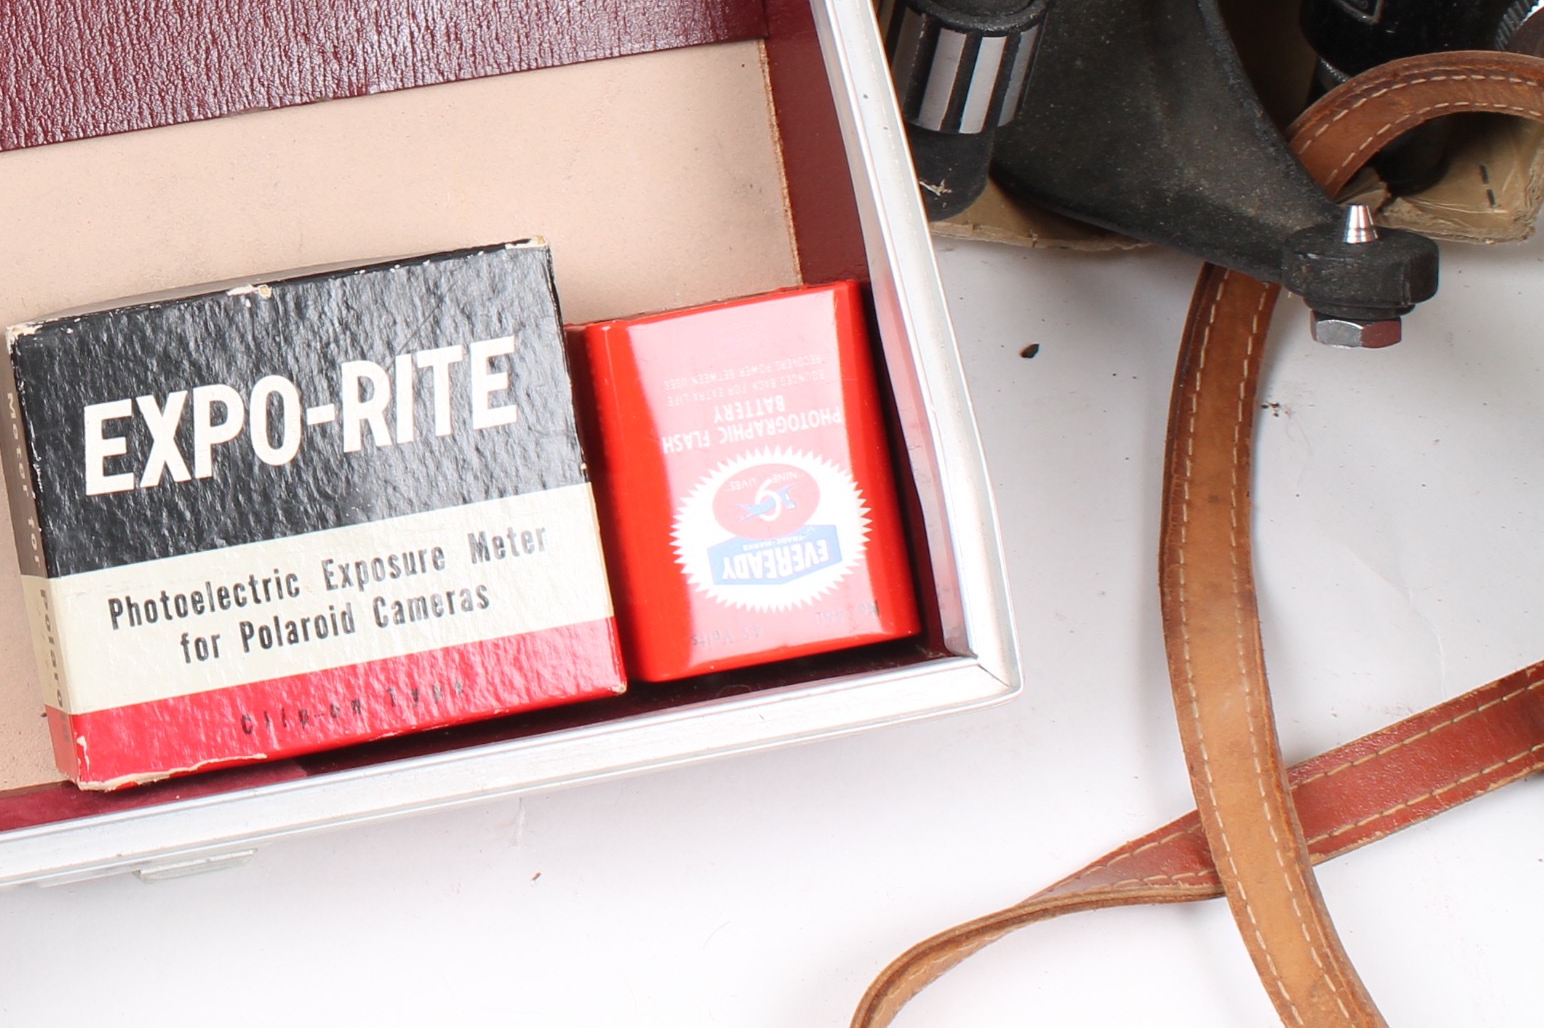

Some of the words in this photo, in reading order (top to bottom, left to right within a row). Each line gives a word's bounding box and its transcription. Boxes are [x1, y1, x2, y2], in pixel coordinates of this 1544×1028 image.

[664, 378, 688, 391] USES
[667, 393, 689, 407] LIFE
[727, 384, 747, 396] FOR
[83, 335, 518, 497] EXPO-RITE
[713, 394, 786, 423] BATTERY
[718, 405, 843, 445] PHOTOGRAPHIC
[661, 429, 711, 455] FLASH
[721, 538, 830, 580] EVEREADY
[108, 568, 301, 631] Photoelectric
[321, 546, 446, 598] Exposure
[468, 523, 547, 565] Meter
[180, 628, 226, 664] for
[240, 593, 356, 653] Polaroid
[373, 579, 490, 629] Cameras
